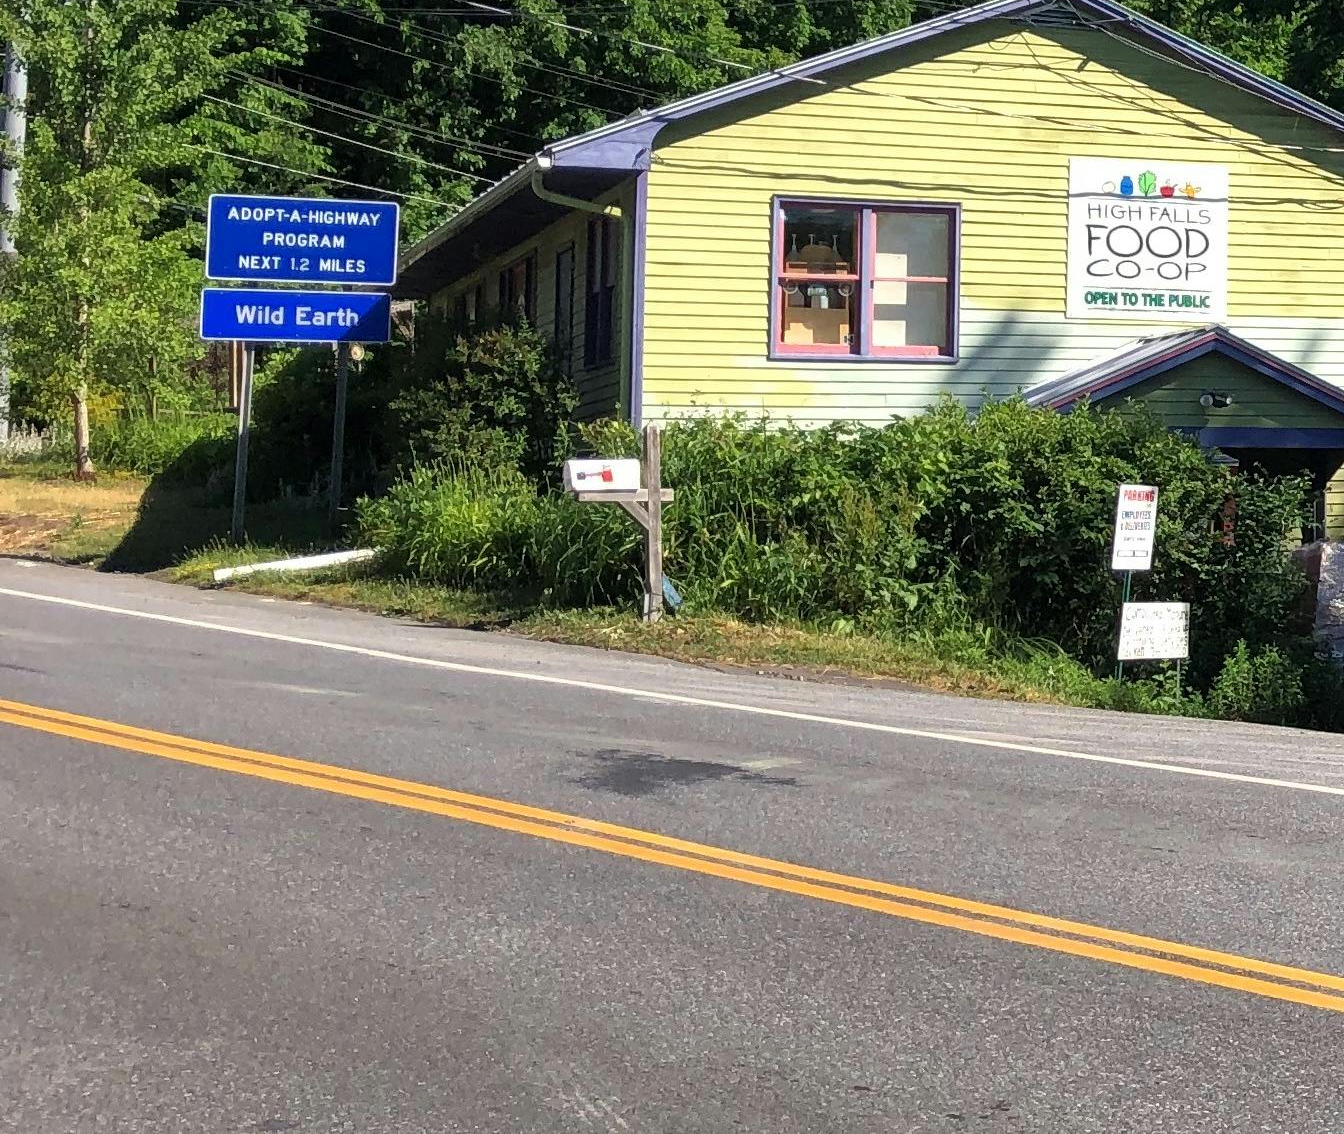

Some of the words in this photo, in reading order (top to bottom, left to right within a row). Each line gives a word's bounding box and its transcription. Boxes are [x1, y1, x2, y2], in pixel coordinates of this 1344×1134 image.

[227, 206, 381, 227] ADOPT-A-HIGHWAY
[1088, 203, 1142, 221] HIGH
[1150, 206, 1211, 225] FALLS
[262, 232, 345, 249] PROGRAM
[1086, 224, 1209, 258] FOOD
[238, 255, 281, 270] NEXT
[291, 257, 310, 271] 1.2
[319, 259, 366, 273] MILES
[1086, 259, 1207, 281] CO-OP
[1084, 291, 1118, 306] OPEN
[1121, 292, 1138, 306] TO
[1142, 293, 1164, 307] THE
[1169, 294, 1210, 308] PUBLIC
[236, 304, 284, 325] Wild
[296, 306, 359, 327] Earth
